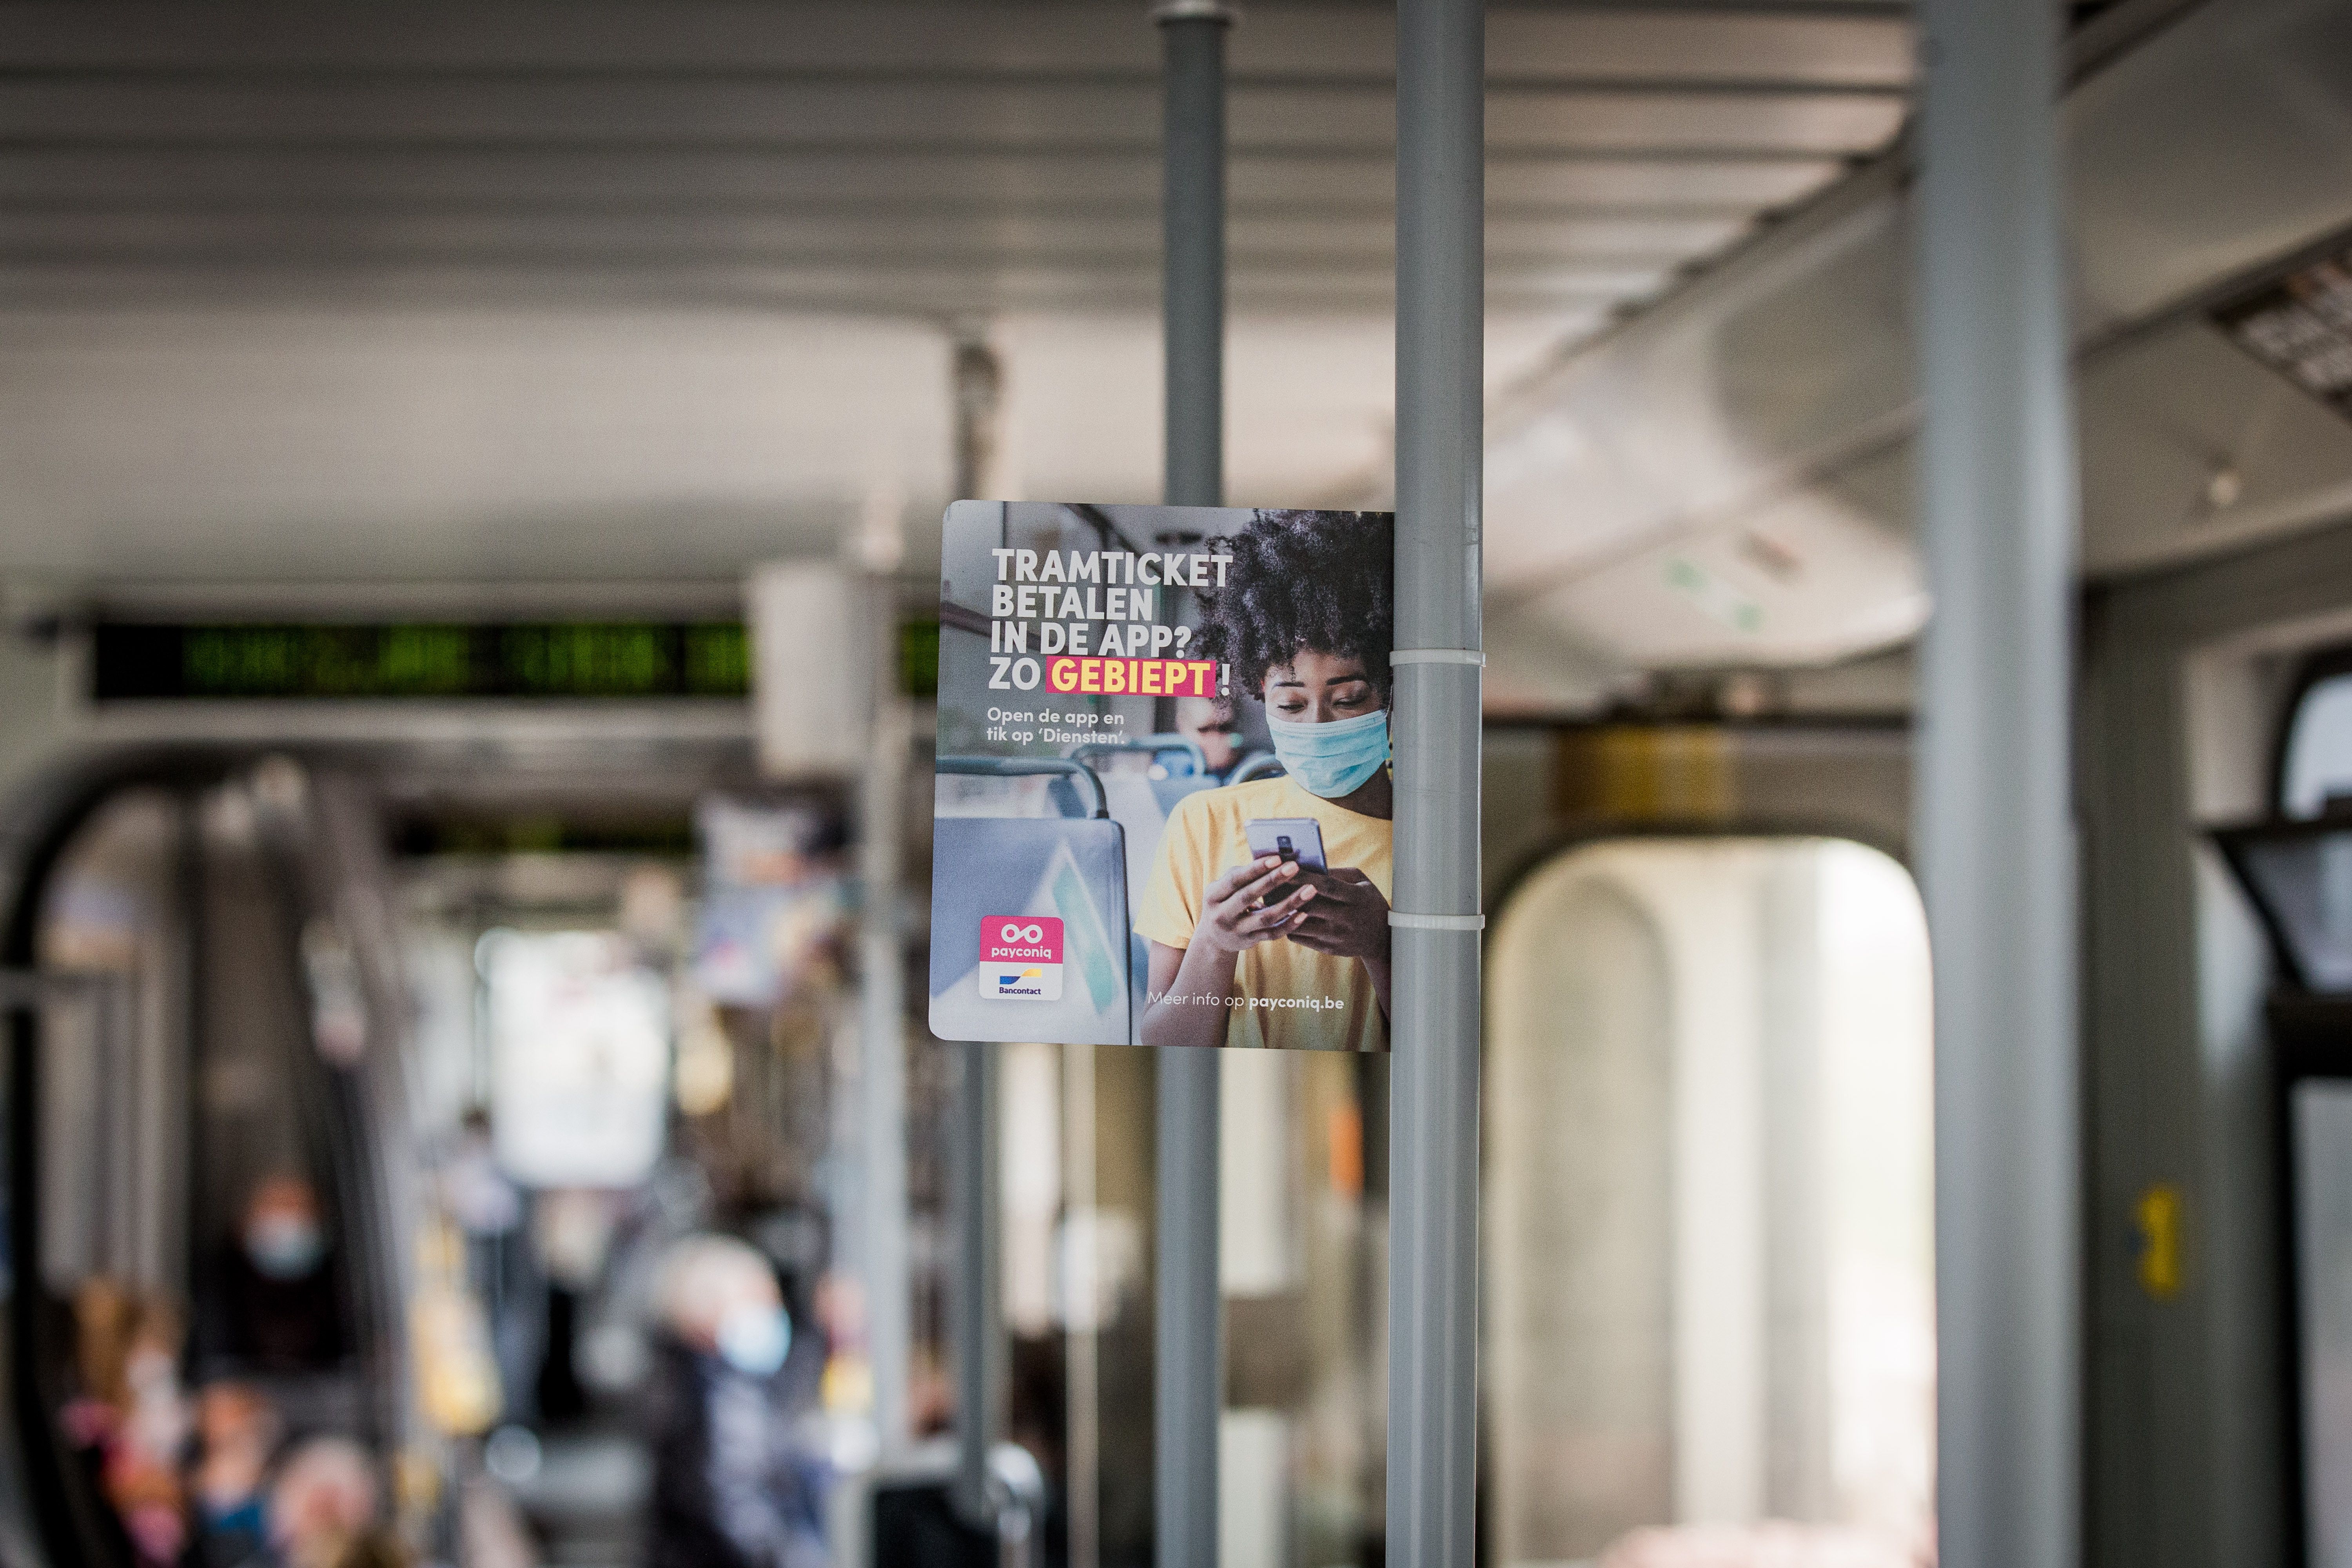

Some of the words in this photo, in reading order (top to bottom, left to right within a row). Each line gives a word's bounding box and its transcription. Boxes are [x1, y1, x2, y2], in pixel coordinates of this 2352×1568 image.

[992, 548, 1233, 587] TRAMTICKET
[992, 584, 1153, 621] BETALEN
[991, 621, 1028, 654] IN
[1040, 622, 1089, 655] DE
[1098, 624, 1191, 659] APP?
[988, 657, 1041, 690] ZO
[1051, 659, 1210, 695] GEBIEPT
[987, 707, 1034, 725] Open
[1038, 708, 1060, 723] de
[1065, 713, 1099, 728] app
[1103, 714, 1124, 725] en
[986, 726, 1008, 741] tik
[1012, 731, 1034, 746] op
[991, 946, 1052, 960] payconiq
[999, 987, 1042, 995] Bancontact
[1147, 991, 1189, 1005] Meer
[1192, 992, 1220, 1006] info
[1224, 996, 1245, 1010] op
[1249, 995, 1345, 1013] payconiq.be
